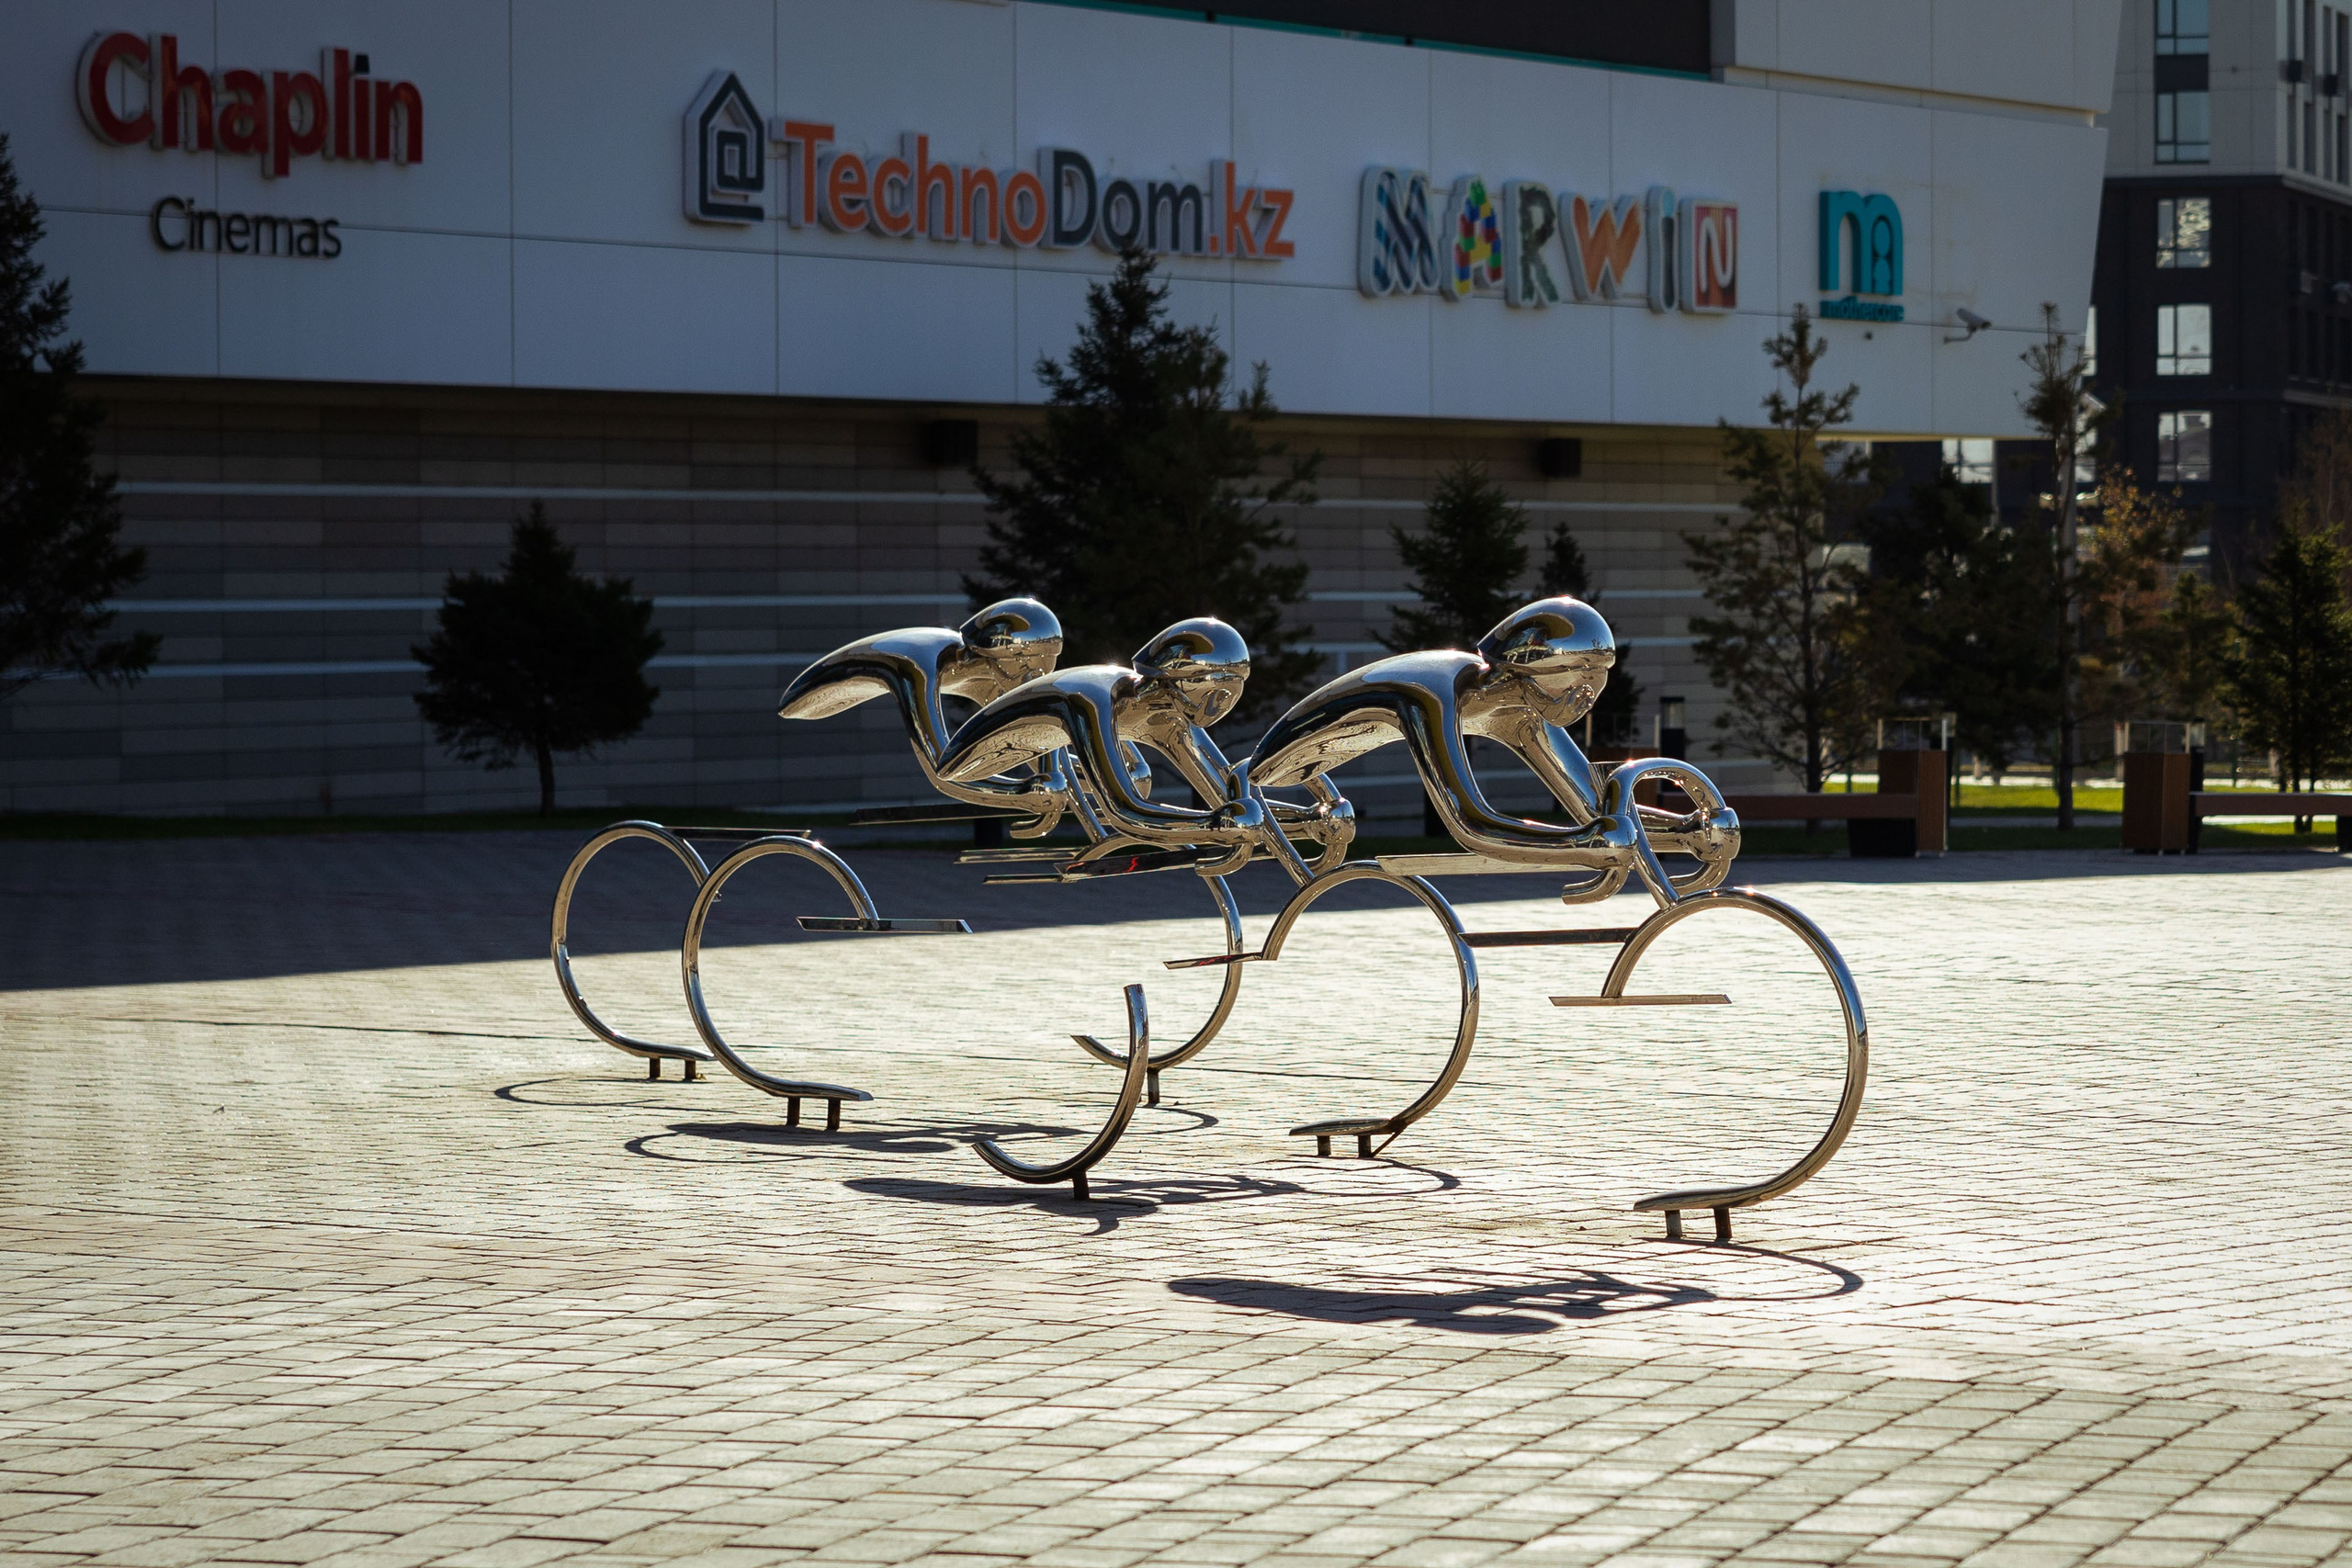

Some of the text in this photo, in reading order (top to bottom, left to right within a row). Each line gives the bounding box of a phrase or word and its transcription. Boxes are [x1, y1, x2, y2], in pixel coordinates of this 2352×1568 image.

[78, 31, 423, 178] Chaplin
[151, 196, 342, 259] Cinemas
[770, 118, 1295, 263] TechnoDom.kz
